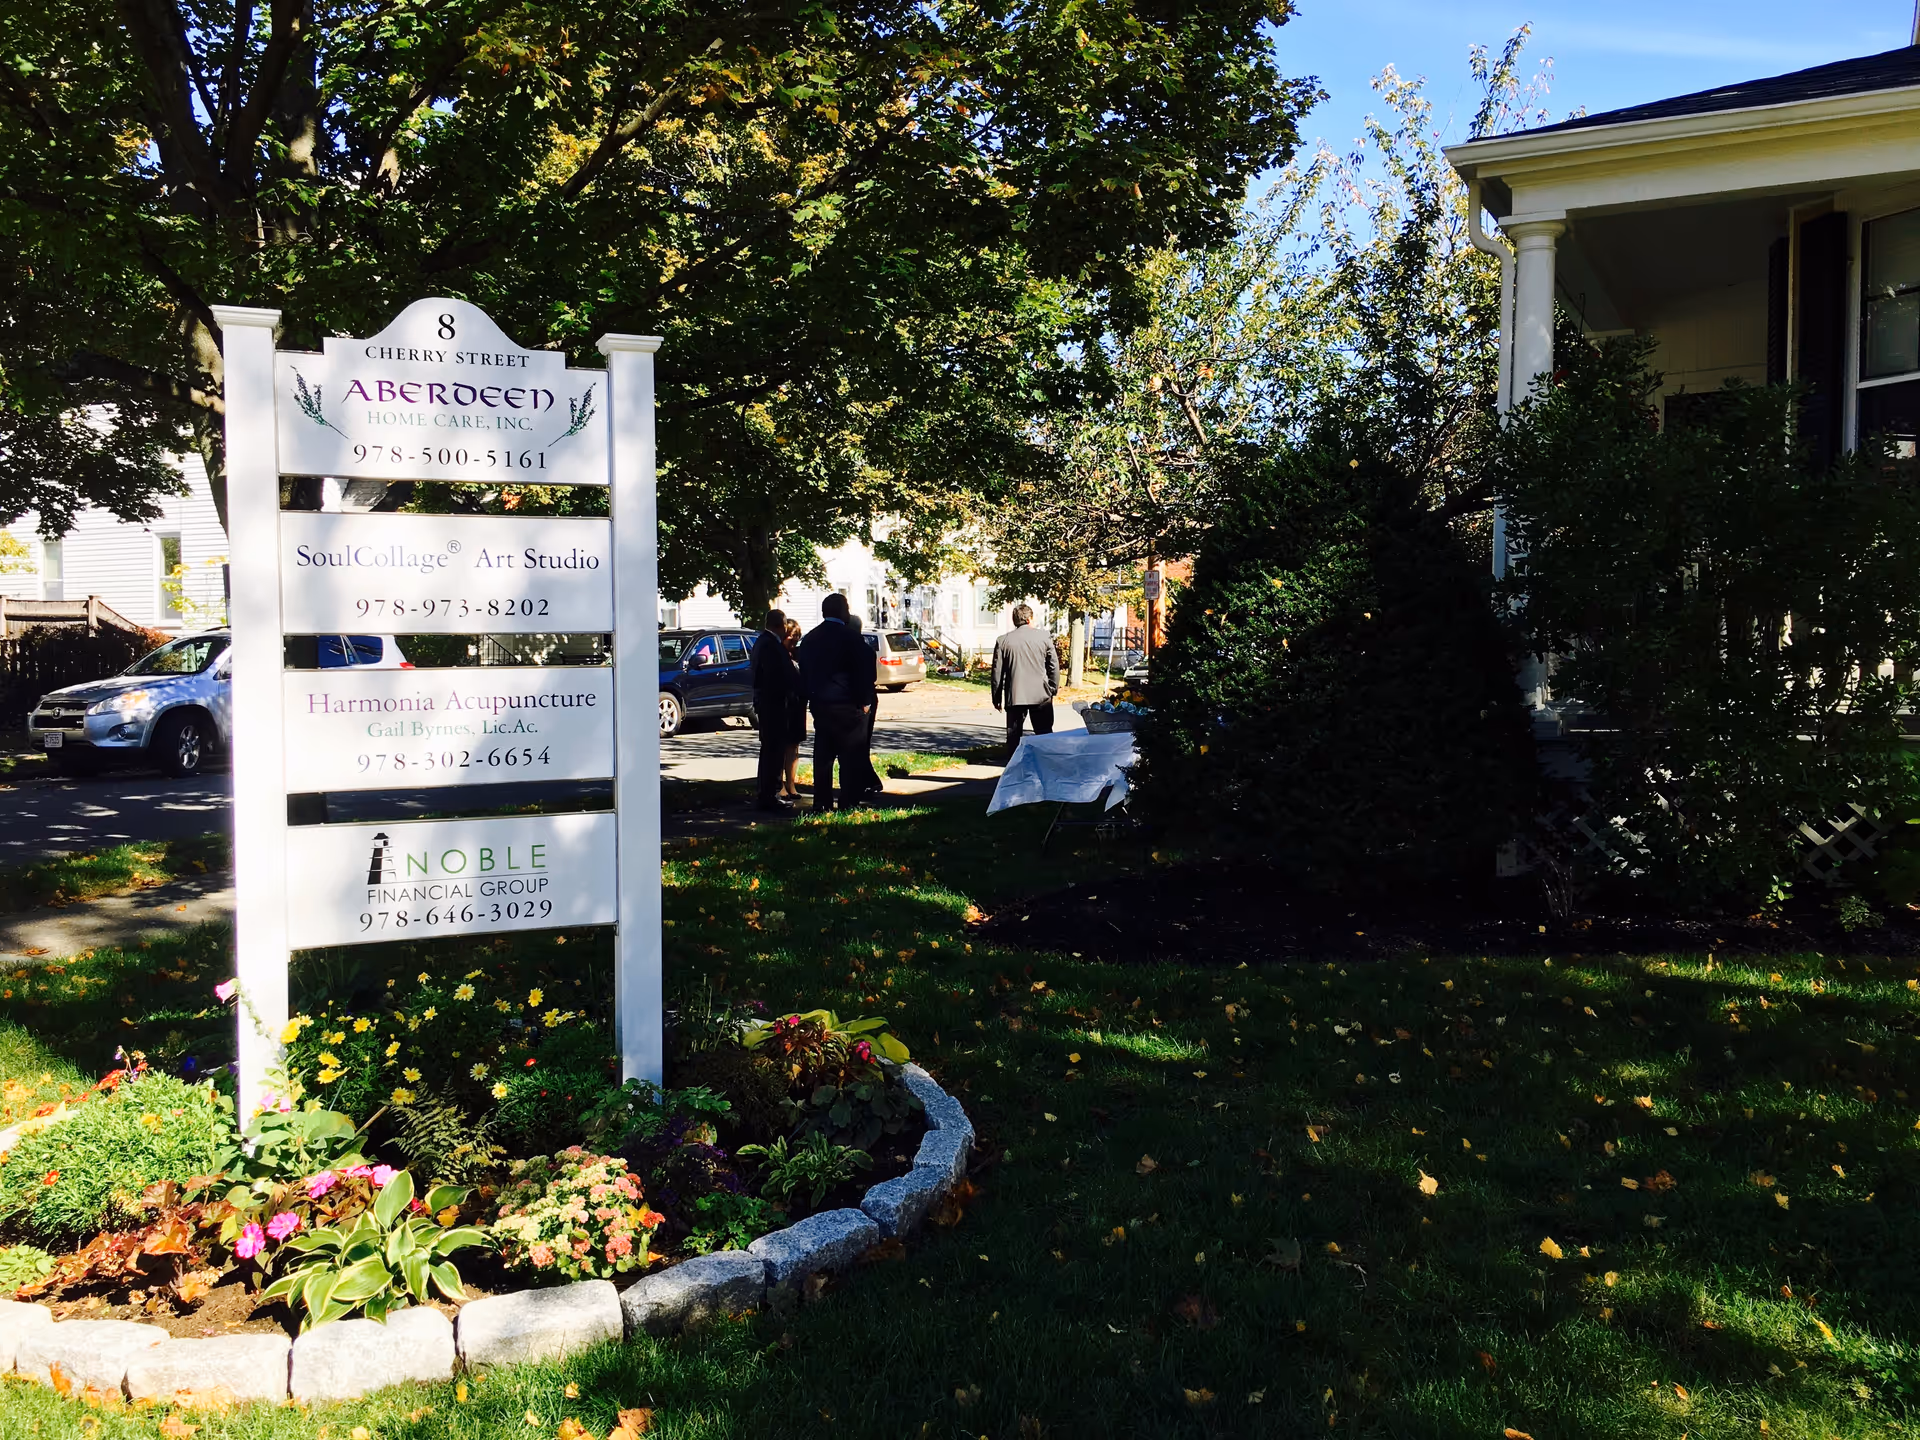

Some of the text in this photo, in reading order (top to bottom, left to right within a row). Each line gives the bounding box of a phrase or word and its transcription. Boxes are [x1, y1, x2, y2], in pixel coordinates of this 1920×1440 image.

[437, 313, 455, 340] 8
[365, 346, 530, 368] CHERRY STREET
[341, 379, 555, 413] ABERDEEN
[367, 410, 533, 431] HOME CARE, INC.
[353, 444, 547, 469] 978-500-5161
[474, 548, 514, 569] Art
[523, 548, 600, 570] Studio
[356, 599, 550, 618] 978-973-8202
[307, 690, 597, 715] Harmonia Acupuncture
[367, 720, 405, 738] Gail
[411, 721, 476, 740] Byrnes,
[357, 745, 551, 773] 978-302-6654
[407, 844, 547, 877] NOBLE
[367, 878, 549, 905] FINANCIAL GROUP
[359, 899, 553, 933] 978-646-3029
